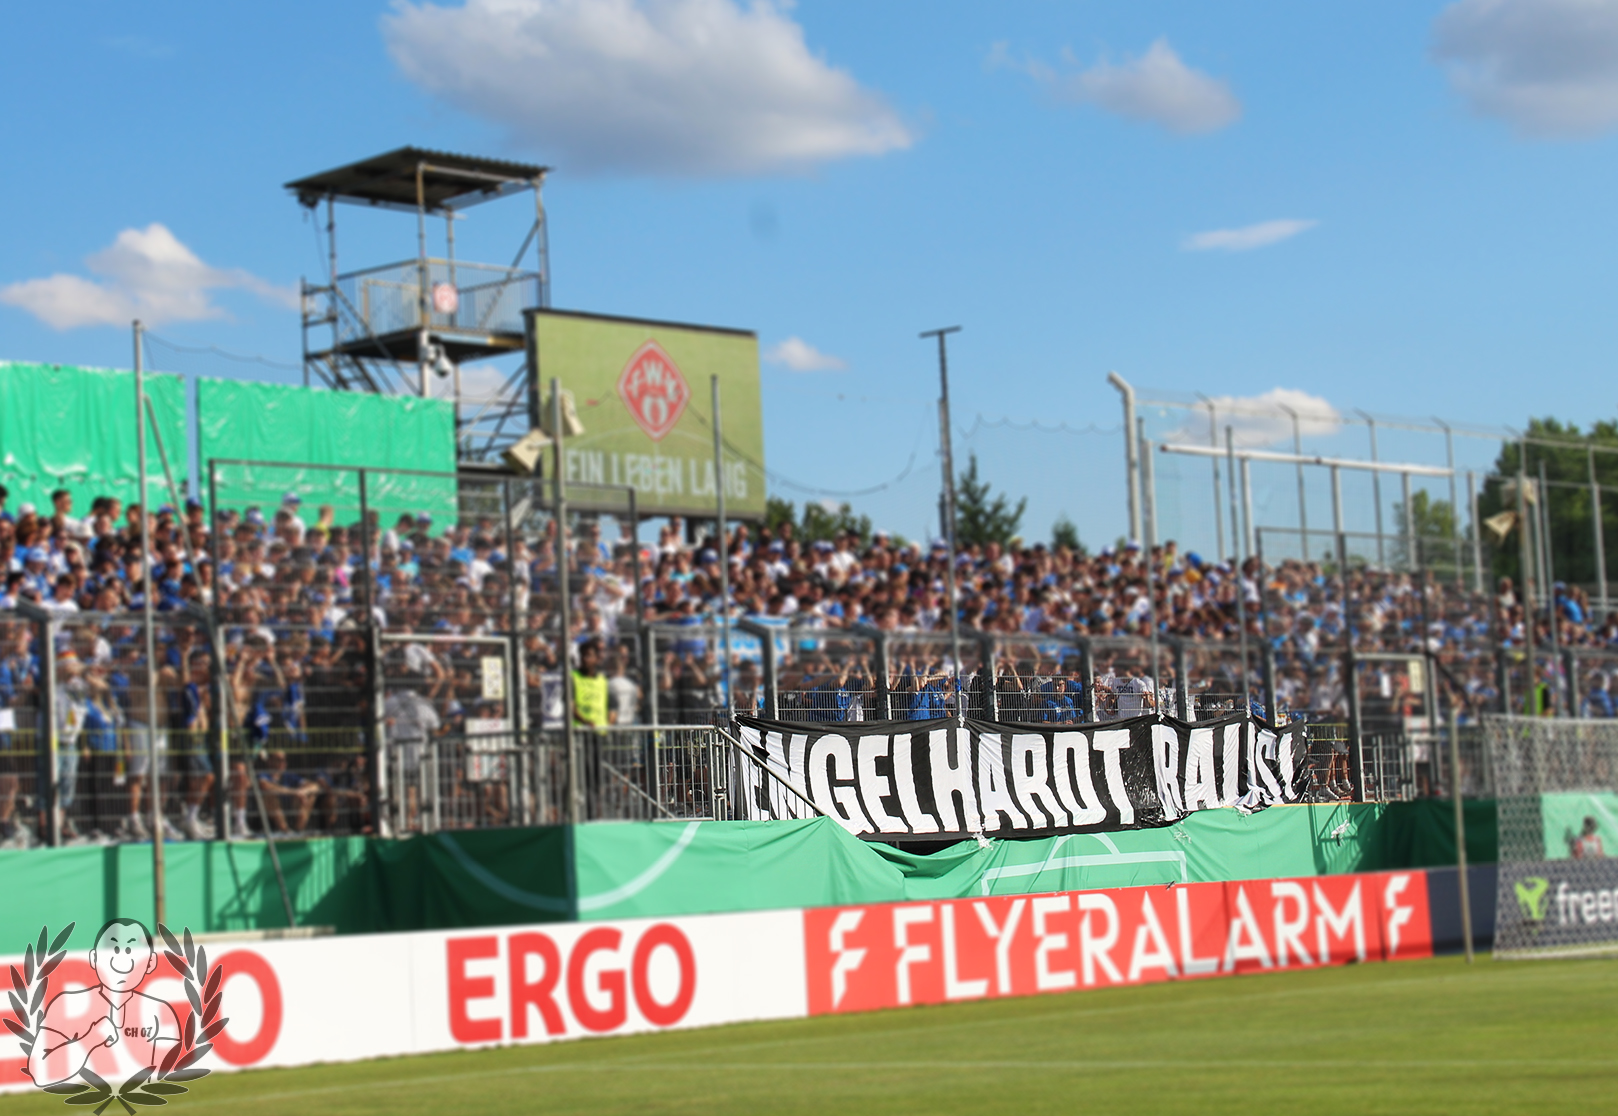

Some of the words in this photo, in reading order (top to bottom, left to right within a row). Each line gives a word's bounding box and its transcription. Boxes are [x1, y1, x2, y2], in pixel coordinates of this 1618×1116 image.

[566, 449, 604, 486] EIN
[611, 452, 684, 495] LEBEN
[739, 724, 1135, 830] ENGELHARDT
[445, 922, 697, 1044] ERGO
[892, 877, 1367, 1006] FLYERALARM
